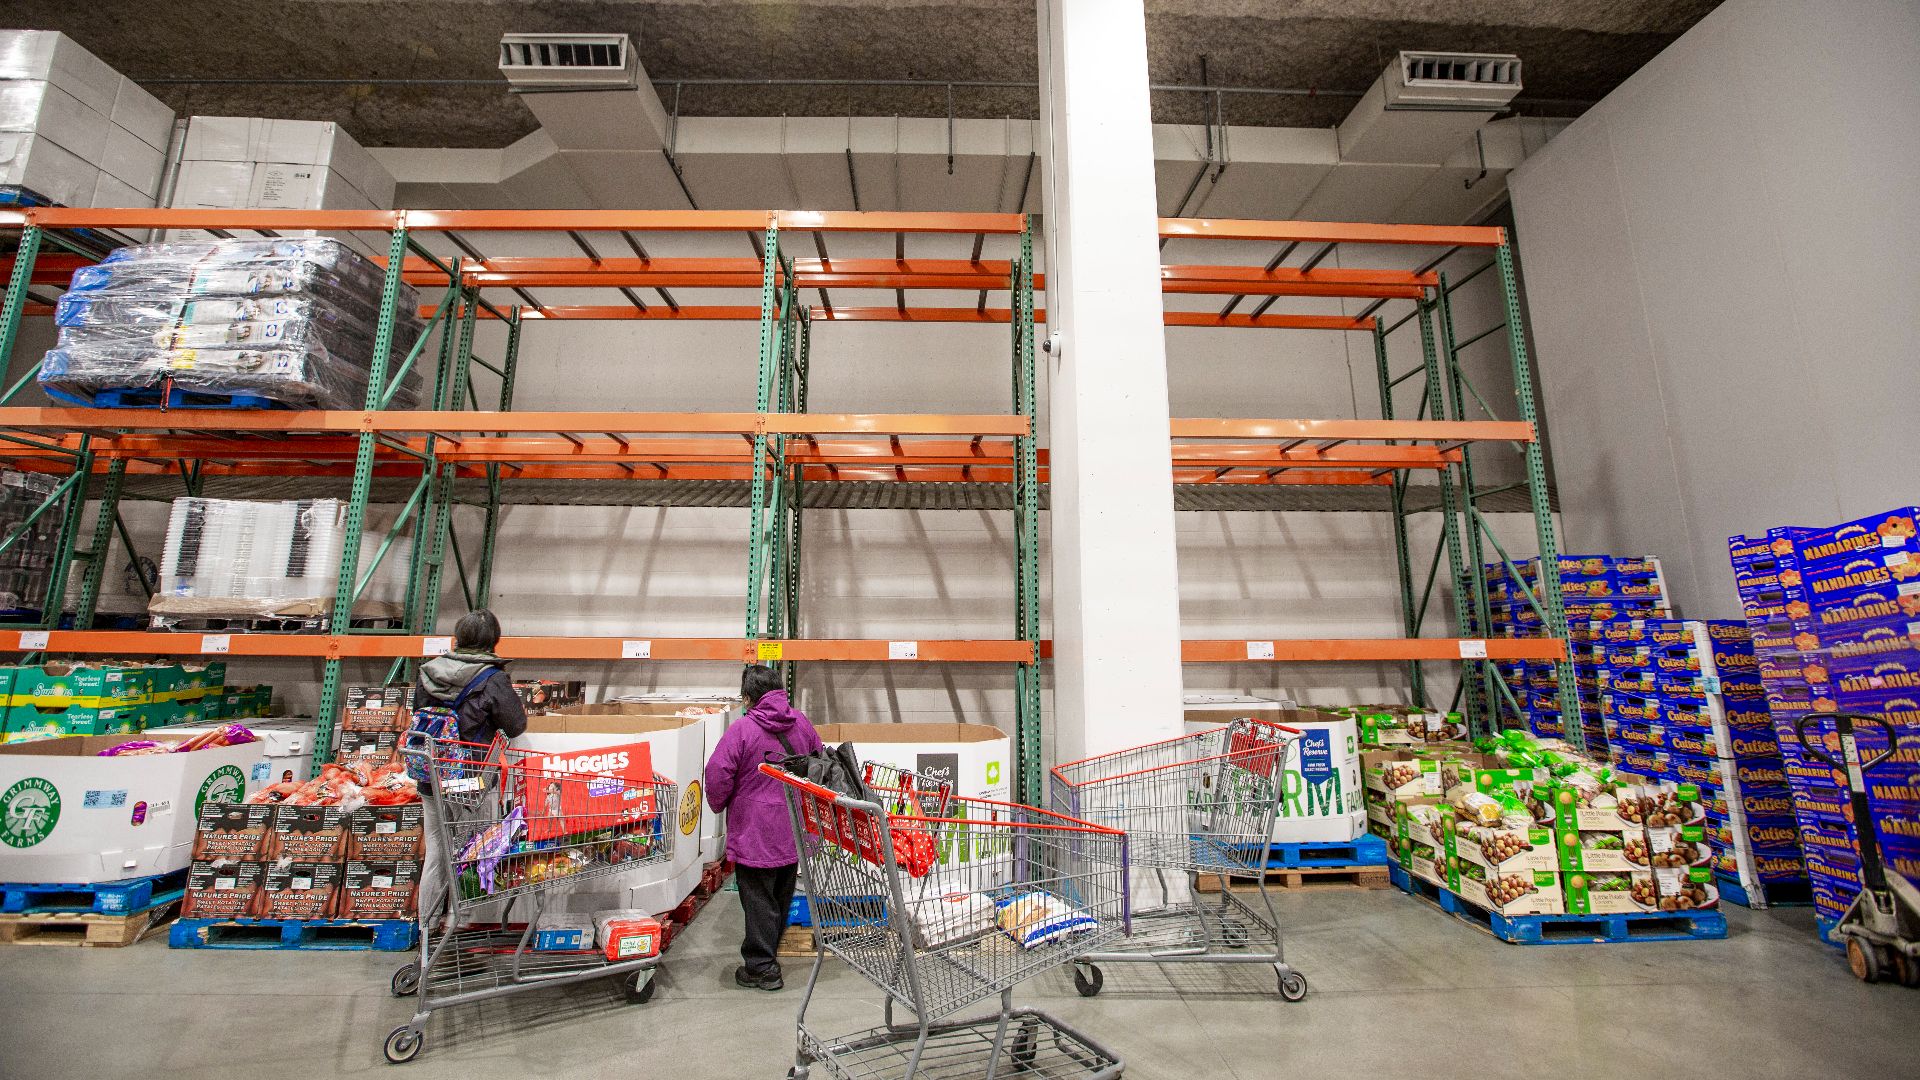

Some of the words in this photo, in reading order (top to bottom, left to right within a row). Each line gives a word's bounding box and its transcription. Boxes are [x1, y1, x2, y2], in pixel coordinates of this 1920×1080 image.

[1803, 531, 1880, 561] MANDARINES
[1616, 563, 1643, 573] Cuties
[1812, 566, 1890, 594] MANDARINES
[1622, 585, 1648, 595] Cuties
[1821, 600, 1900, 624] MANDARINS
[1605, 629, 1629, 639] Cuties
[1653, 631, 1681, 642] Cuties
[1610, 654, 1634, 665] Cuties
[1658, 657, 1687, 668] Cuties
[1715, 652, 1760, 667] Cuties
[1614, 679, 1639, 690] Cuties
[1839, 672, 1920, 692] MANARINS
[1663, 684, 1691, 694] Cuties
[1618, 705, 1643, 715] Cuties
[1667, 710, 1697, 721] Cuties
[1727, 710, 1771, 725] Cuties
[1622, 729, 1648, 740] Cuties
[1305, 739, 1324, 747] Chef's
[1672, 737, 1702, 749] Cuties
[1732, 739, 1778, 754] Cuties
[1303, 747, 1328, 756] Reserve
[543, 751, 630, 779] HUGGIES
[1626, 754, 1652, 765] Cuties
[925, 766, 951, 777] Chef's
[1678, 765, 1707, 777] Cuties
[1738, 767, 1786, 782] Cuties
[1787, 767, 1831, 778] MANDARINS
[201, 767, 245, 793] GRIMMWAY
[3, 779, 61, 804] GRIMMWAY
[1744, 797, 1790, 812] Cuties
[1795, 800, 1840, 813] MANDARINS
[1, 832, 45, 847] FARMS
[1750, 826, 1795, 841] Cuties
[1803, 834, 1851, 848] MANDARINS
[1755, 857, 1800, 872] Cuties
[1808, 861, 1858, 882] MANDARINS
